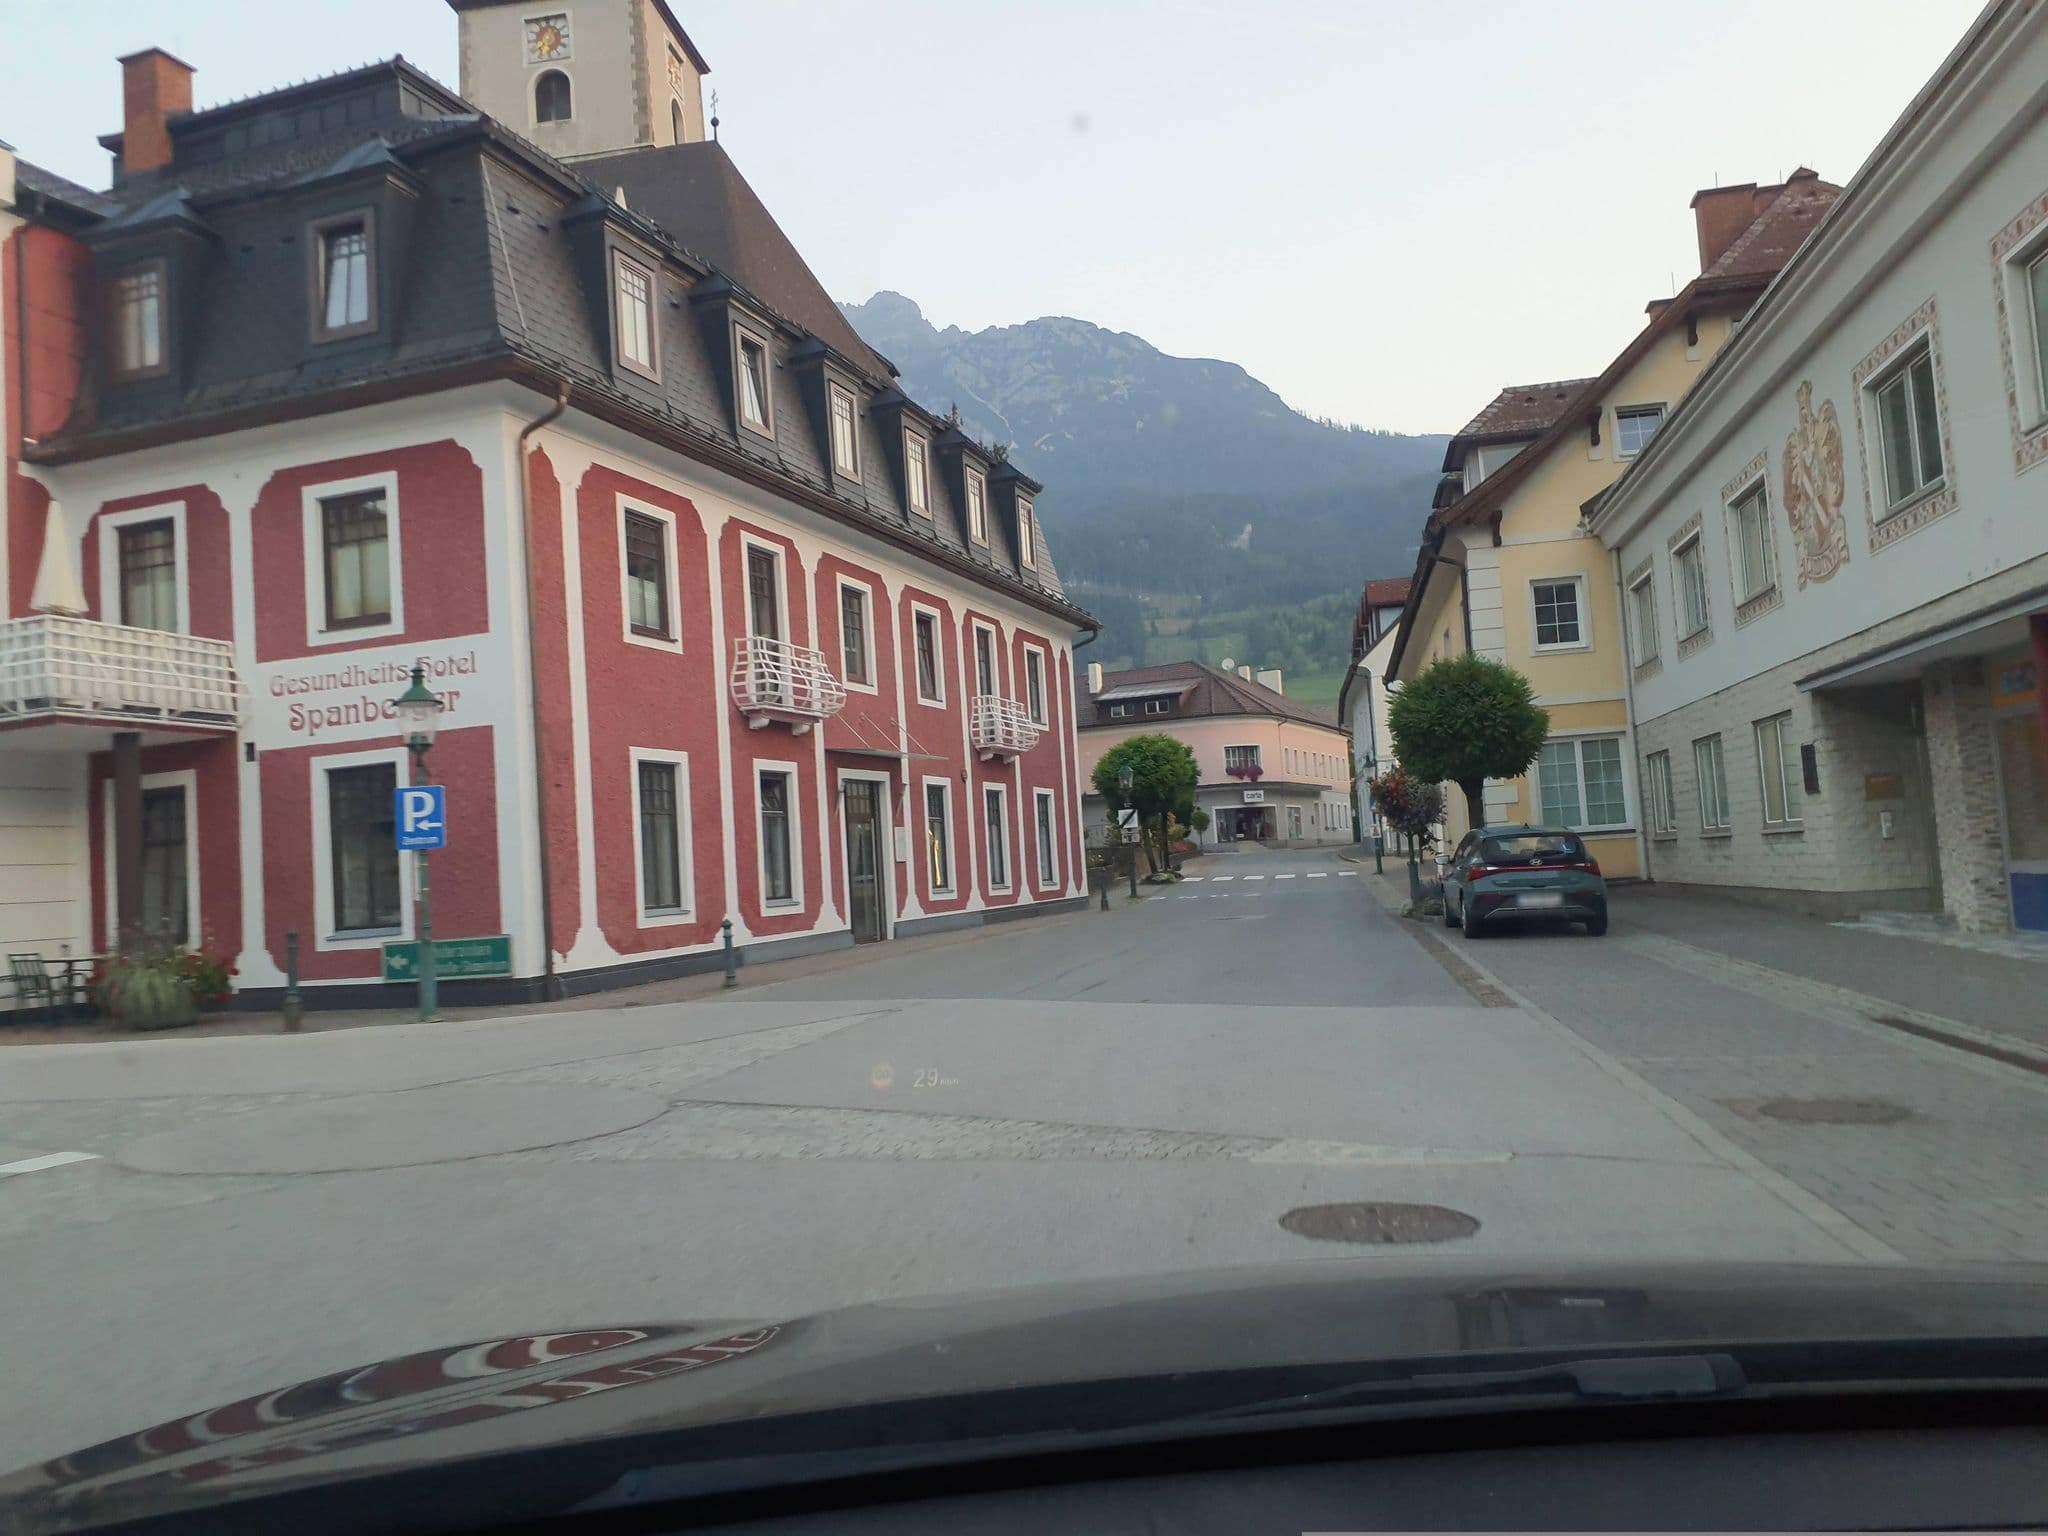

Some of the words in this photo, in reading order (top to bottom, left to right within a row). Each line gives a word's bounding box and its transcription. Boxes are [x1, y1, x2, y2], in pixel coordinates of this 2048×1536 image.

[270, 663, 409, 697] Gesundheits
[404, 791, 435, 832] P
[912, 1068, 938, 1087] 29
